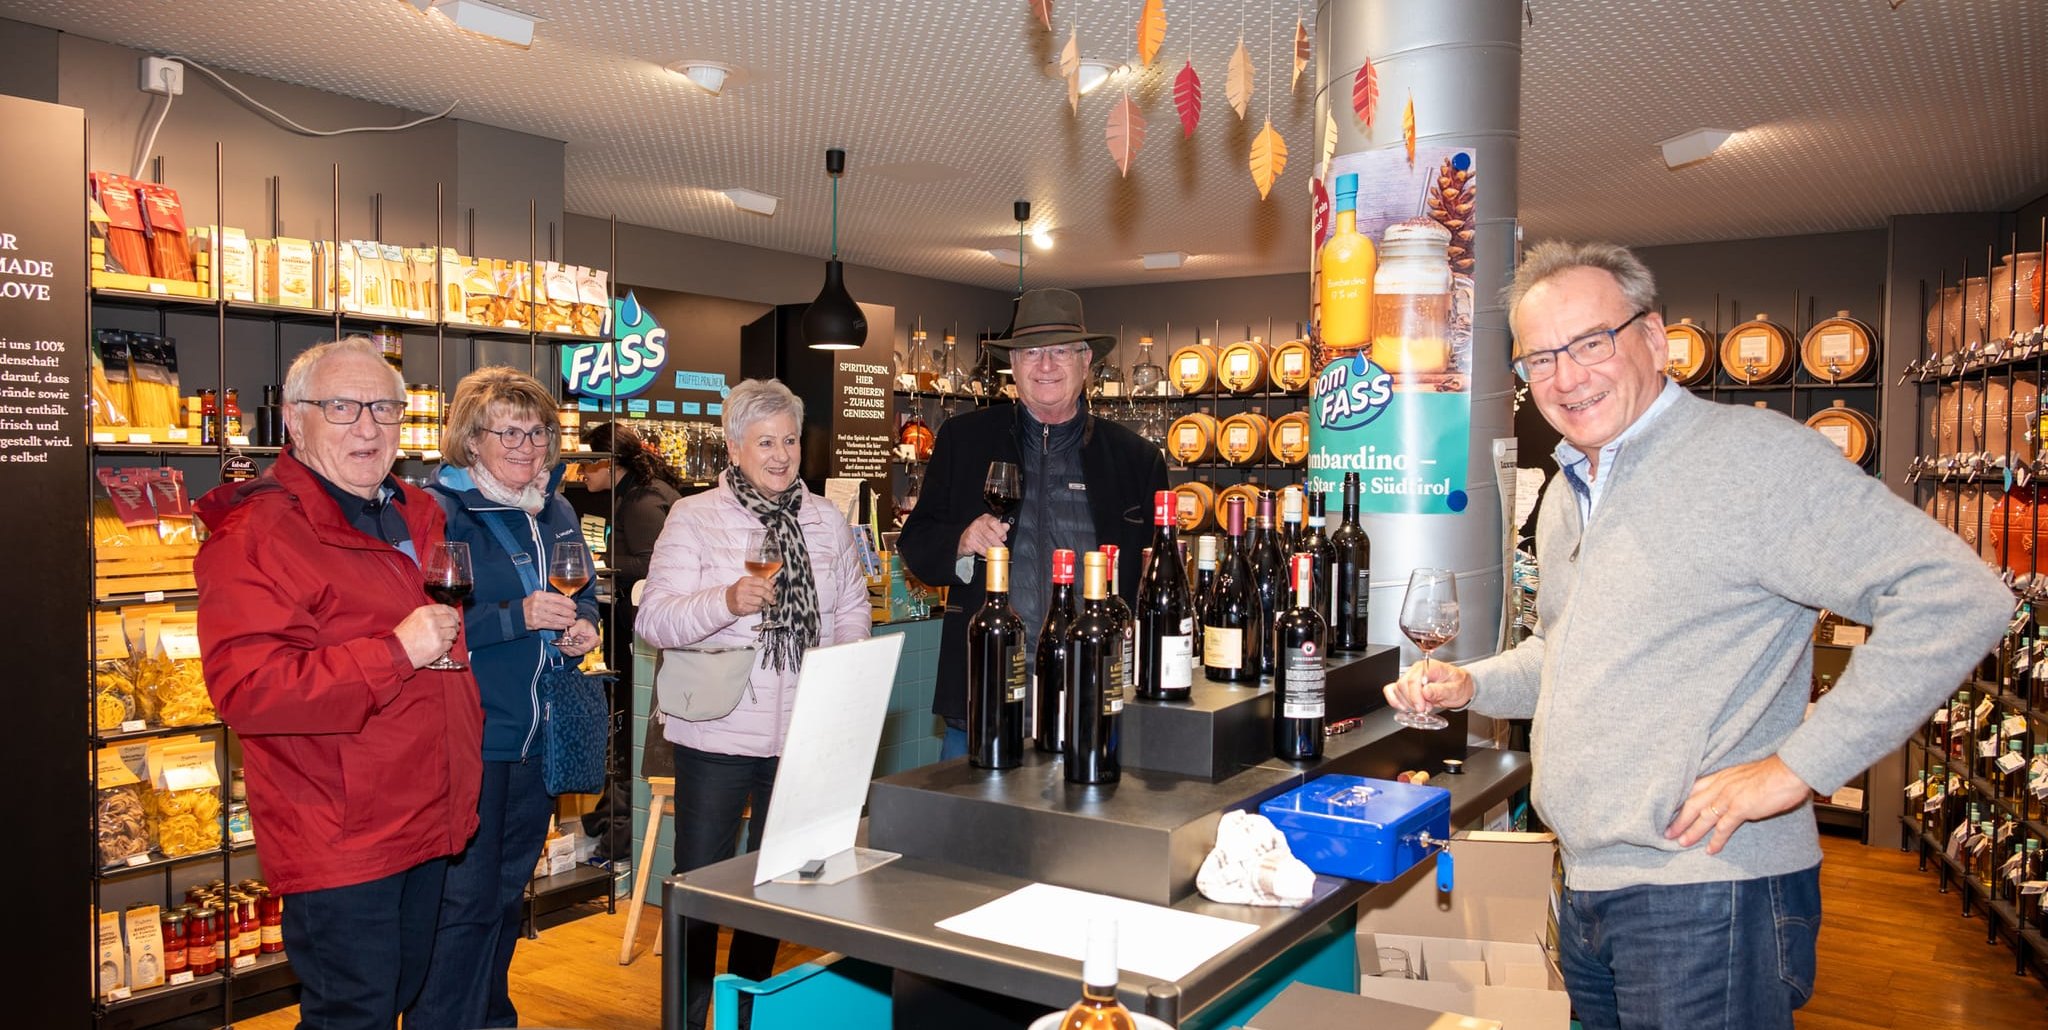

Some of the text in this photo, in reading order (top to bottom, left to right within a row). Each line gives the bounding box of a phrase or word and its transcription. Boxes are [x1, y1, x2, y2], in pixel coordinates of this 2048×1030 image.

[0, 233, 19, 250] R
[9, 341, 31, 350] uns
[35, 340, 65, 352] 100%
[569, 328, 666, 390] FASS
[1, 371, 70, 384] darauf, dass
[856, 375, 873, 385] HIER
[1314, 366, 1346, 399] vom
[0, 387, 70, 399] rände sowie
[844, 386, 885, 396] PROBIEREN
[849, 397, 885, 408] ZUHAUSE
[1321, 375, 1391, 425] FASS
[25, 404, 69, 415] enthält.
[843, 409, 885, 419] GENIESSEN!
[36, 421, 60, 431] und
[45, 437, 73, 447] wird.
[10, 452, 48, 463] selbst!
[1313, 476, 1336, 493] Star
